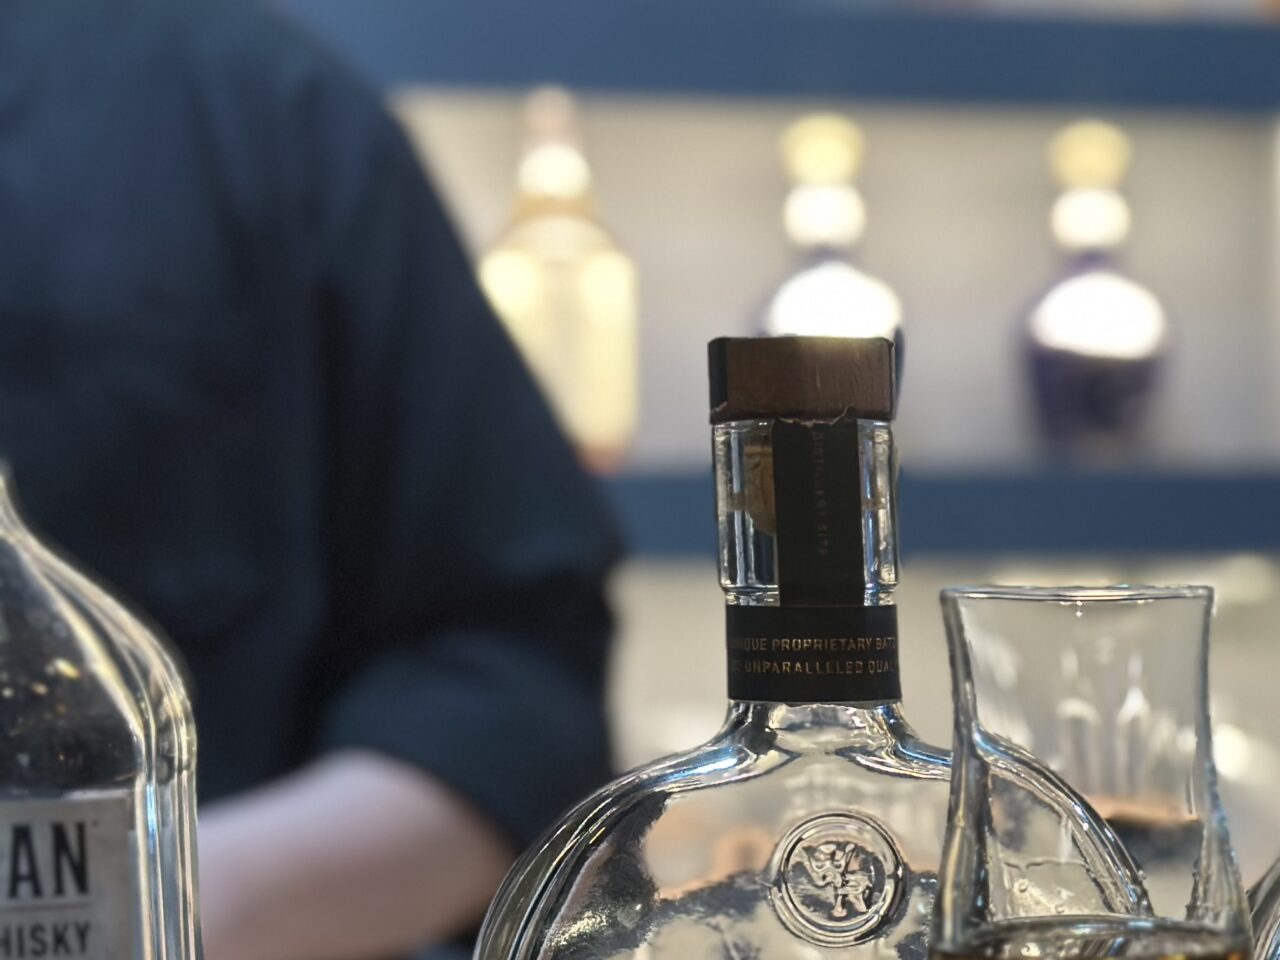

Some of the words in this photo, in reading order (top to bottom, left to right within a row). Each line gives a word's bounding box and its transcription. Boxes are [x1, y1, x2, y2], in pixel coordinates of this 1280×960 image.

[772, 636, 872, 652] PROPRIETARY
[868, 659, 895, 675] QUAL
[8, 821, 90, 898] AN
[0, 920, 91, 958] HISKY
